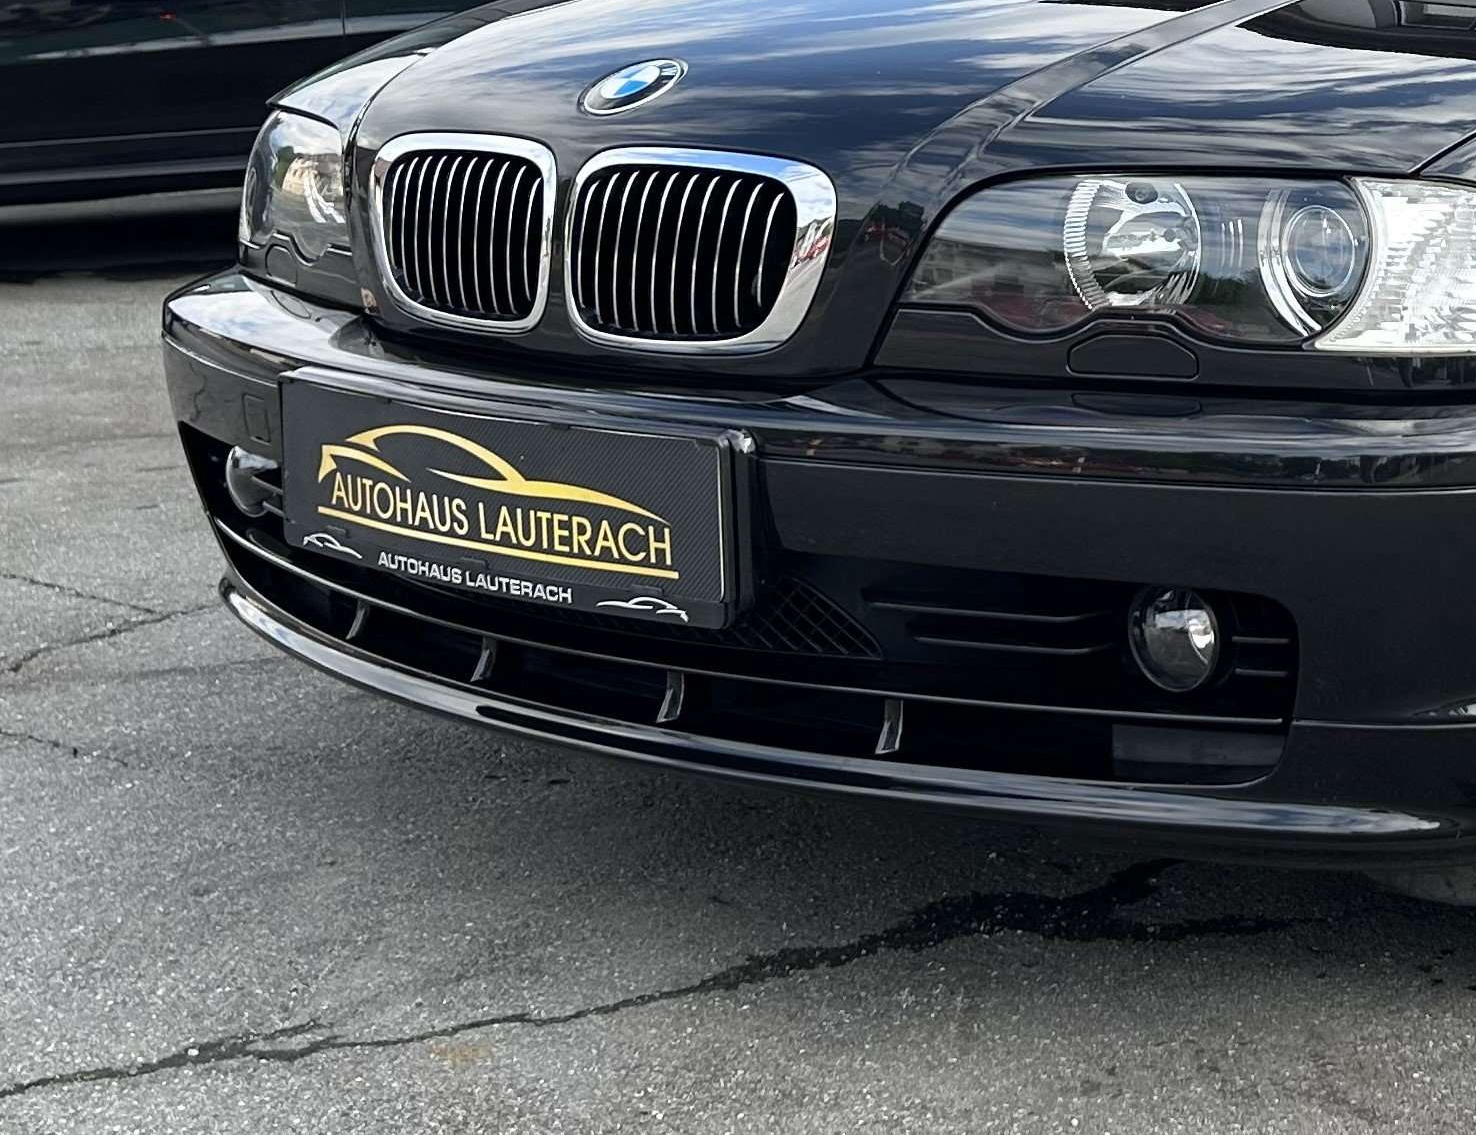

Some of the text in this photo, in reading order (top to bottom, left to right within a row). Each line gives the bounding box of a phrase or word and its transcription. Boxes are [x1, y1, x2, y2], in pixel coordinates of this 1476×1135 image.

[330, 471, 673, 566] AUTOHAUS LAUTERACH
[377, 551, 573, 604] AUTOHAUS LAUTERACH
